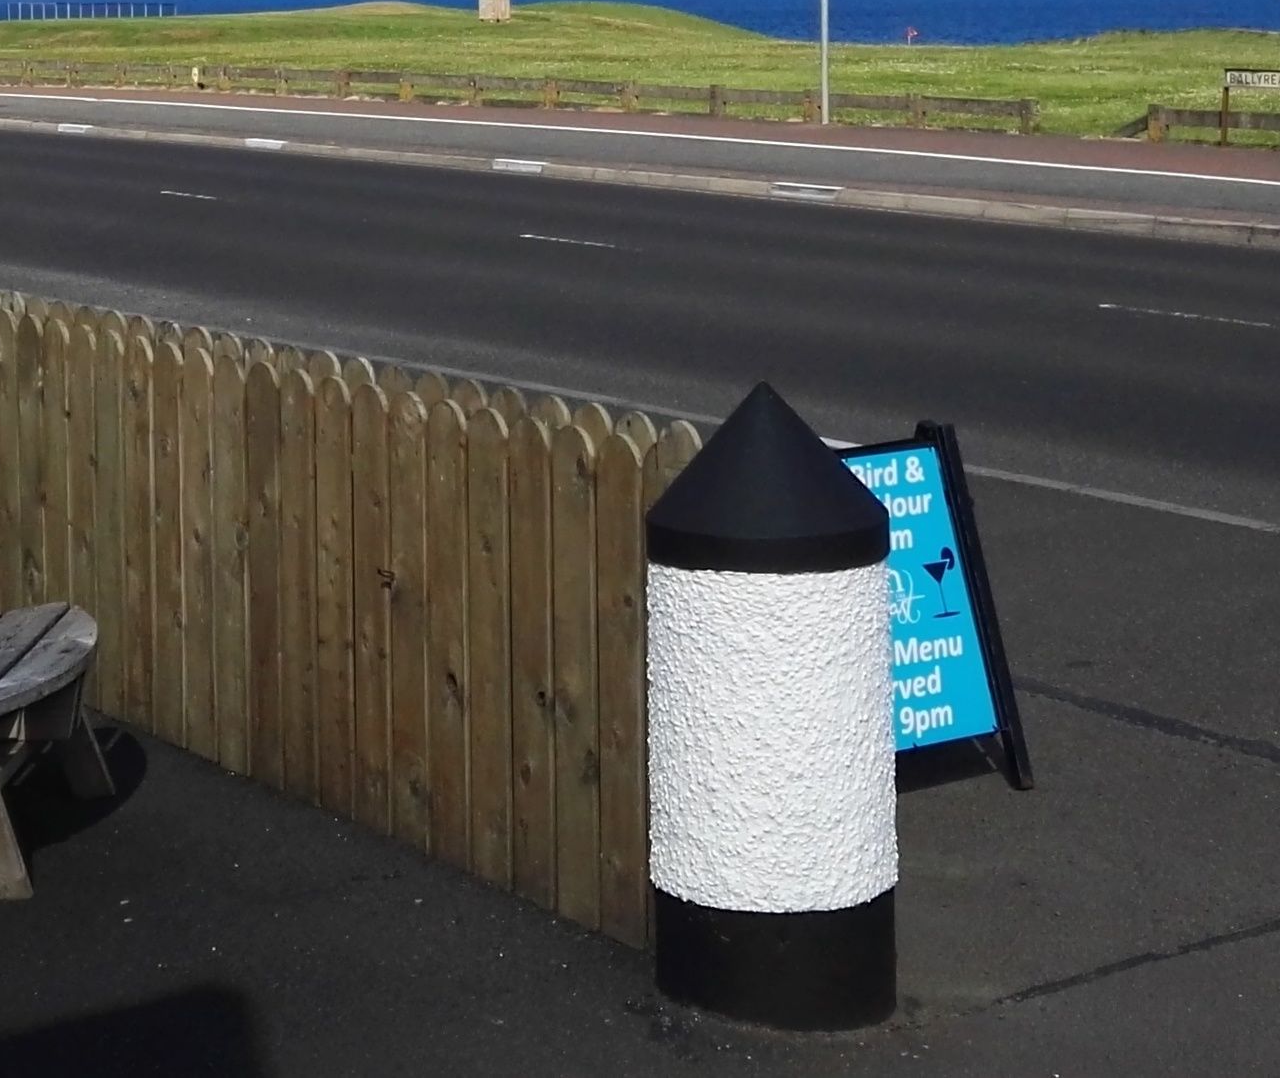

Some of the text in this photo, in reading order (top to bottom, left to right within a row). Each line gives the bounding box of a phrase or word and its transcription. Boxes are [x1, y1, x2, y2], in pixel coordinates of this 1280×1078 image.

[905, 456, 925, 483] &
[894, 635, 963, 666] Menu
[891, 665, 941, 701] rved
[900, 705, 953, 738] 9pm
